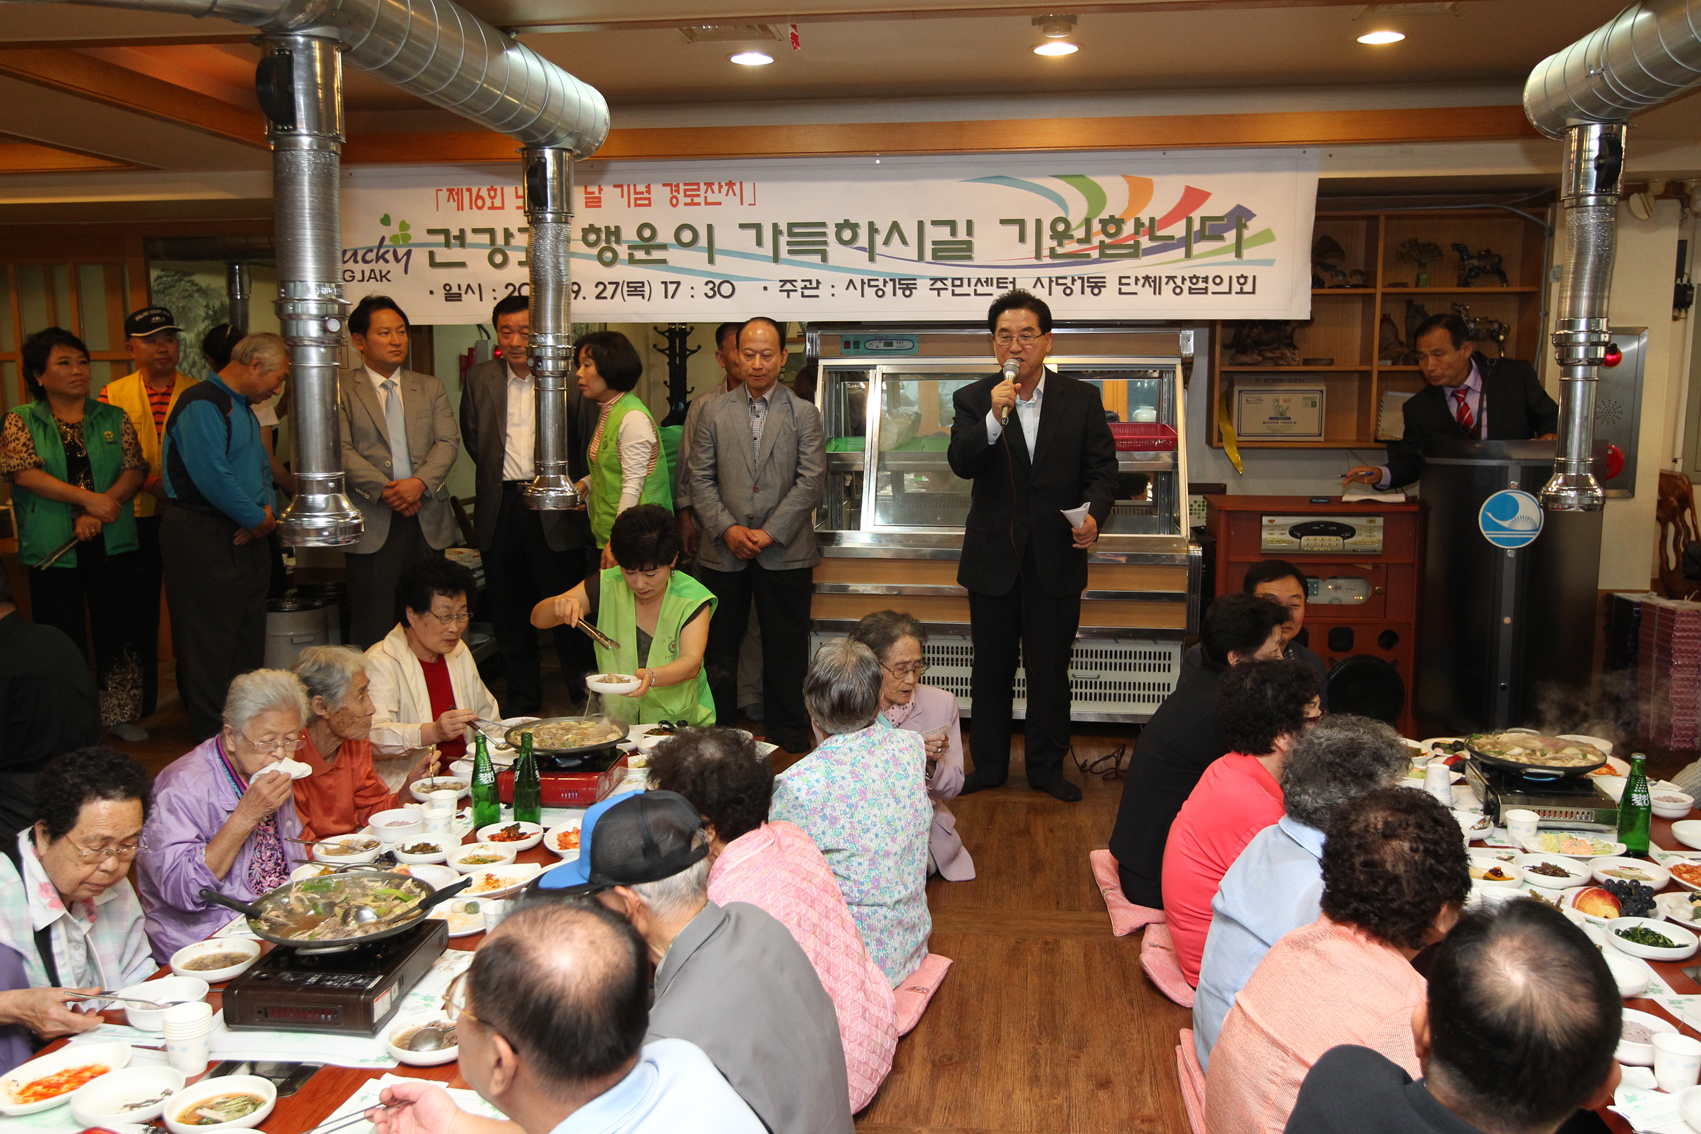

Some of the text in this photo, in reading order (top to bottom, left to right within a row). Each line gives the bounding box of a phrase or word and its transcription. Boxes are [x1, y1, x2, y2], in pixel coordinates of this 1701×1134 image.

[583, 184, 604, 209] 날
[612, 183, 652, 209] 기념
[581, 222, 714, 267] 행운이
[738, 218, 973, 264] 가득하시길
[999, 214, 1248, 261] 기원합니다
[342, 235, 412, 275] ucky
[342, 269, 392, 283] GJAK
[845, 277, 918, 299] 사당1동
[929, 277, 1016, 298] 주민센터
[1032, 275, 1107, 297] 사당1동
[1118, 273, 1257, 296] 단체장협의회
